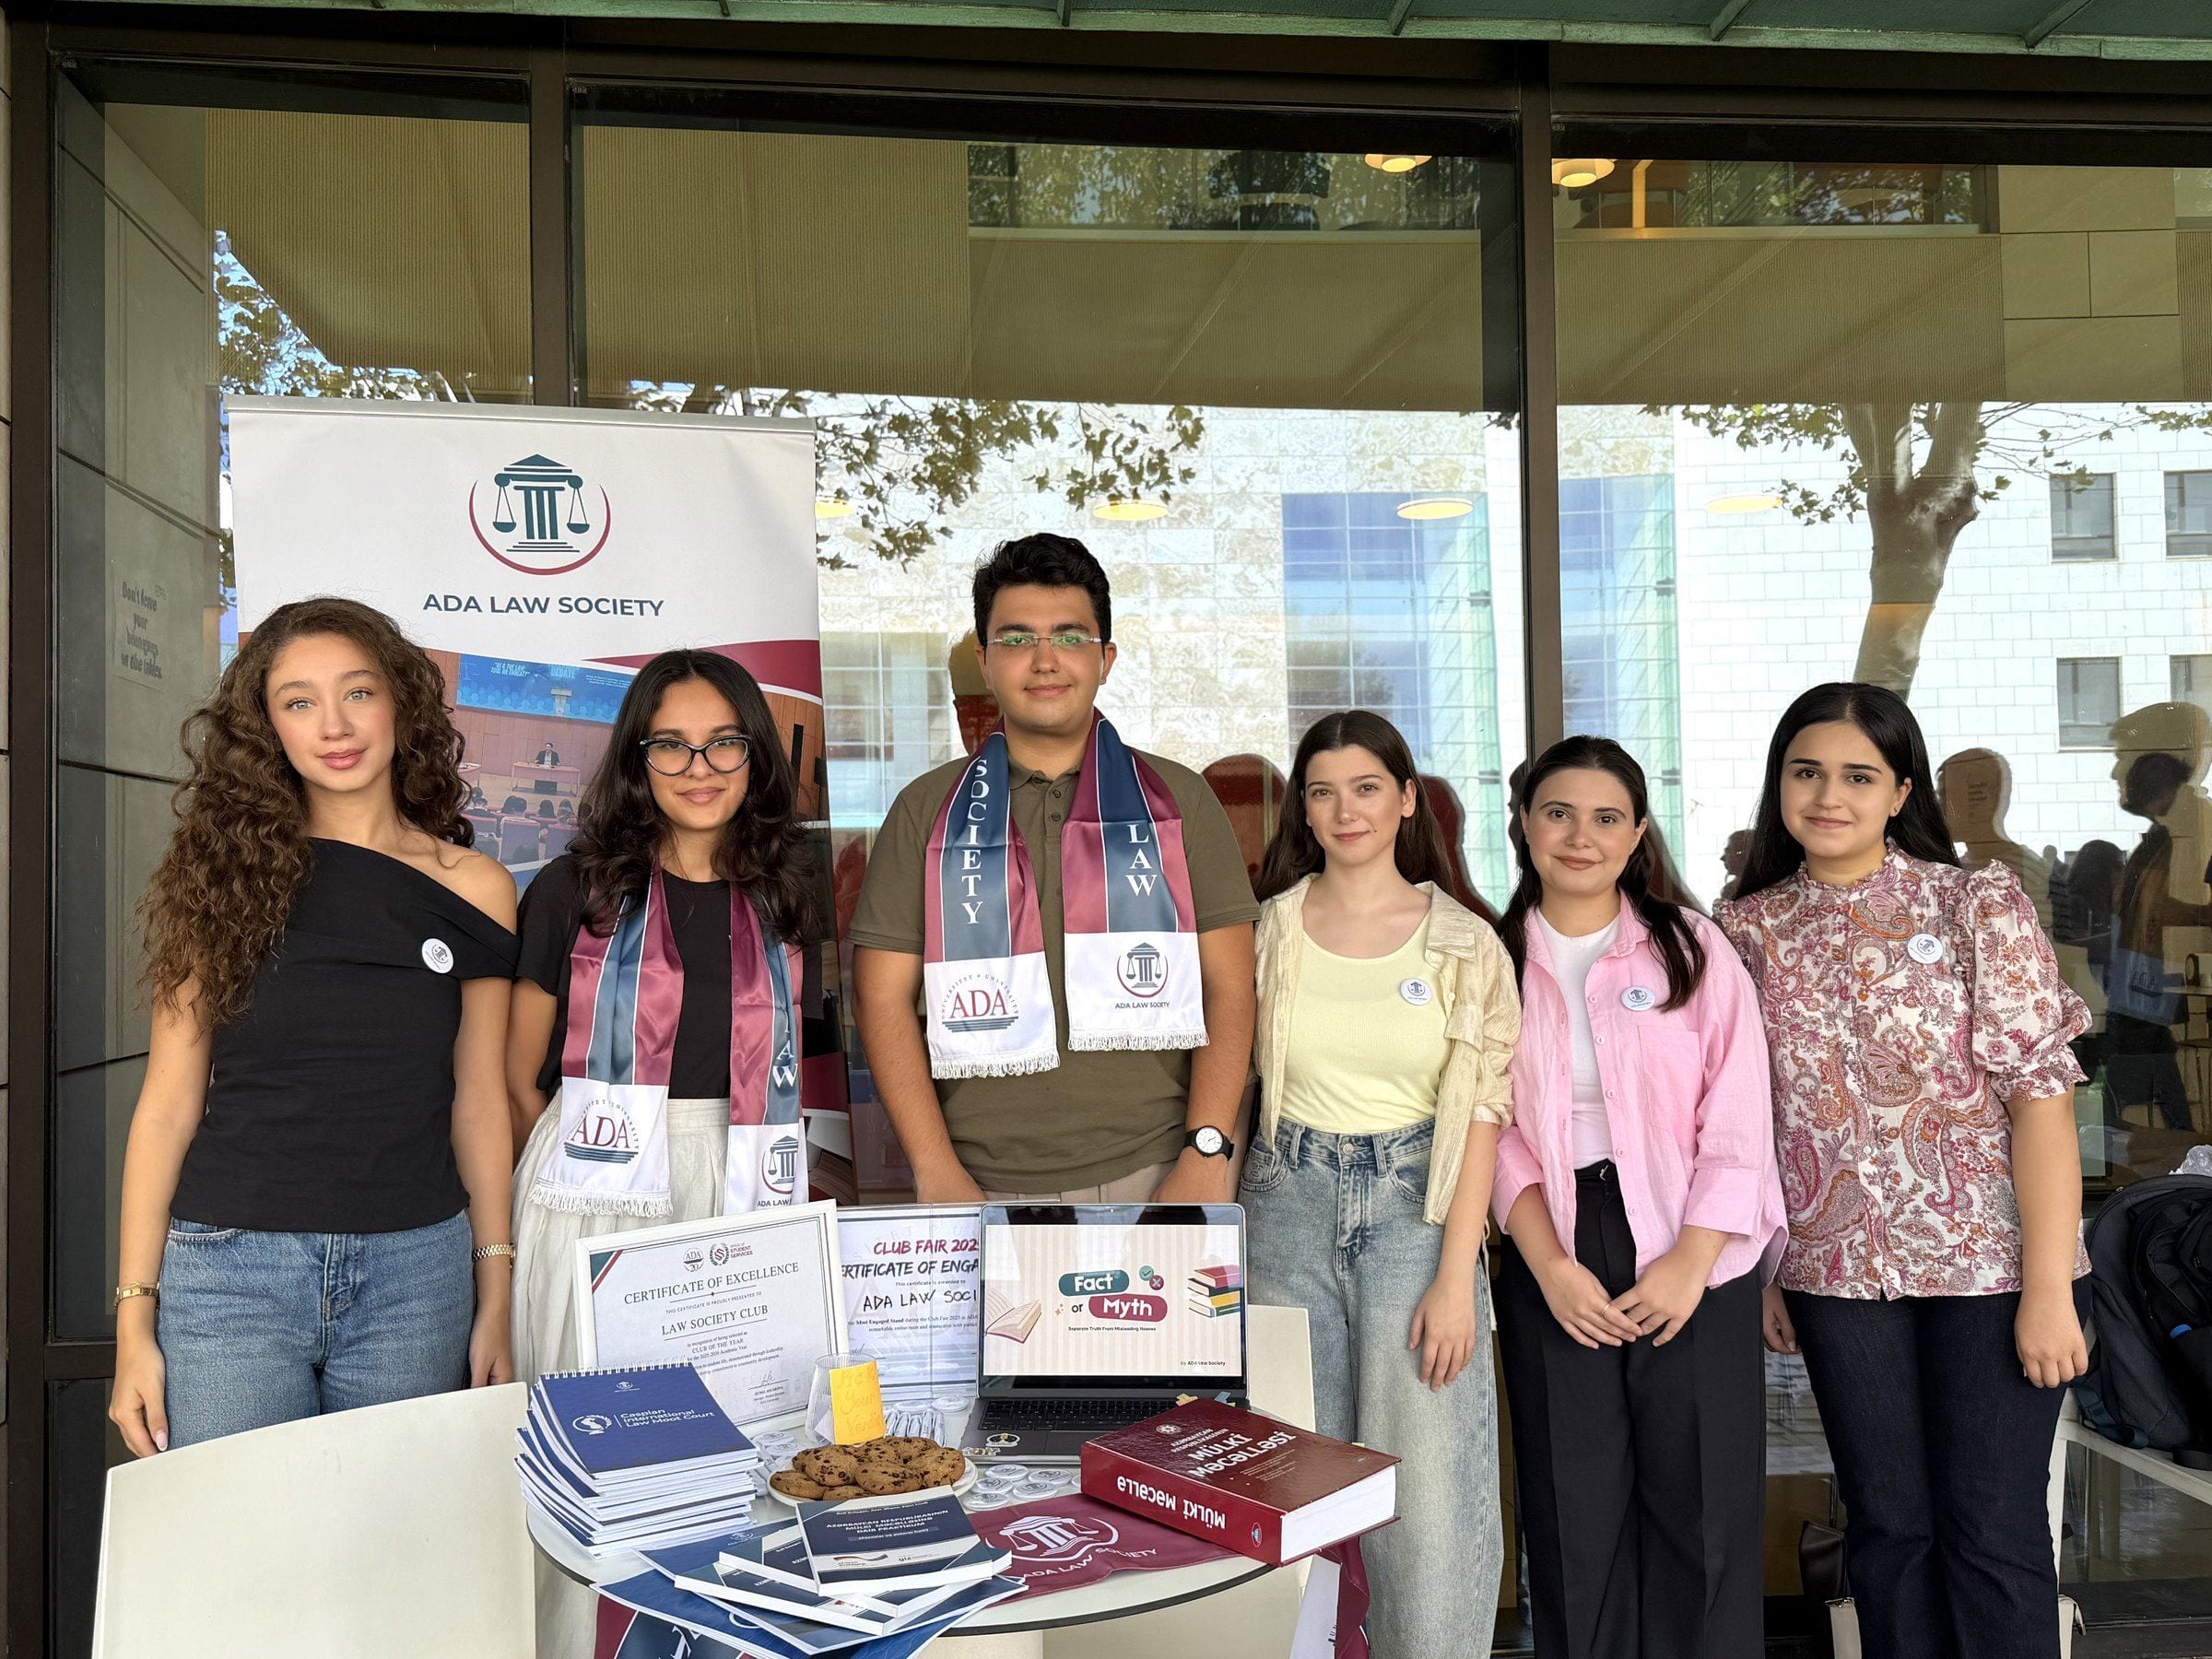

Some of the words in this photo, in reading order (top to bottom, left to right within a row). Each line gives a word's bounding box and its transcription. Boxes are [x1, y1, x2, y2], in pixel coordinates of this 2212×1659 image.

[422, 594, 483, 613] ADA
[489, 596, 550, 614] LAW
[558, 596, 665, 617] SOCIETY
[550, 667, 576, 678] DEBATE
[961, 759, 990, 924] SOCIETY
[1125, 824, 1158, 897] LAW
[948, 988, 1009, 1018] ADA
[570, 1113, 630, 1148] ADA
[686, 1251, 702, 1261] ADA
[873, 1241, 912, 1255] CLUB
[915, 1239, 948, 1254] FAIR
[950, 1238, 979, 1253] 202
[917, 1260, 937, 1276] OF
[941, 1258, 979, 1274] ENGA
[624, 1279, 704, 1305] CERTIFICATE
[707, 1277, 723, 1288] OF
[725, 1262, 799, 1285] EXCELLENCE
[1074, 1273, 1113, 1292] Fact
[677, 1302, 705, 1312] CERTIFICATE
[863, 1295, 893, 1312] ADA
[900, 1289, 936, 1307] LAW
[944, 1289, 977, 1303] SOCI
[1071, 1303, 1083, 1313] or
[1103, 1297, 1152, 1319] Myth
[661, 1321, 688, 1335] LAW
[690, 1310, 737, 1330] SOCIETY
[740, 1304, 769, 1319] CLUB
[620, 1409, 665, 1418] Caspian
[623, 1409, 695, 1423] International
[1187, 1433, 1253, 1461] MÜLKİ
[1188, 1431, 1297, 1477] MƏCƏLLƏSİ
[1116, 1476, 1176, 1511] MƏCƏLLƏ
[1182, 1500, 1226, 1529] MÜLKİ
[1058, 1554, 1094, 1572] LAW
[1095, 1547, 1158, 1559] SOCIETY
